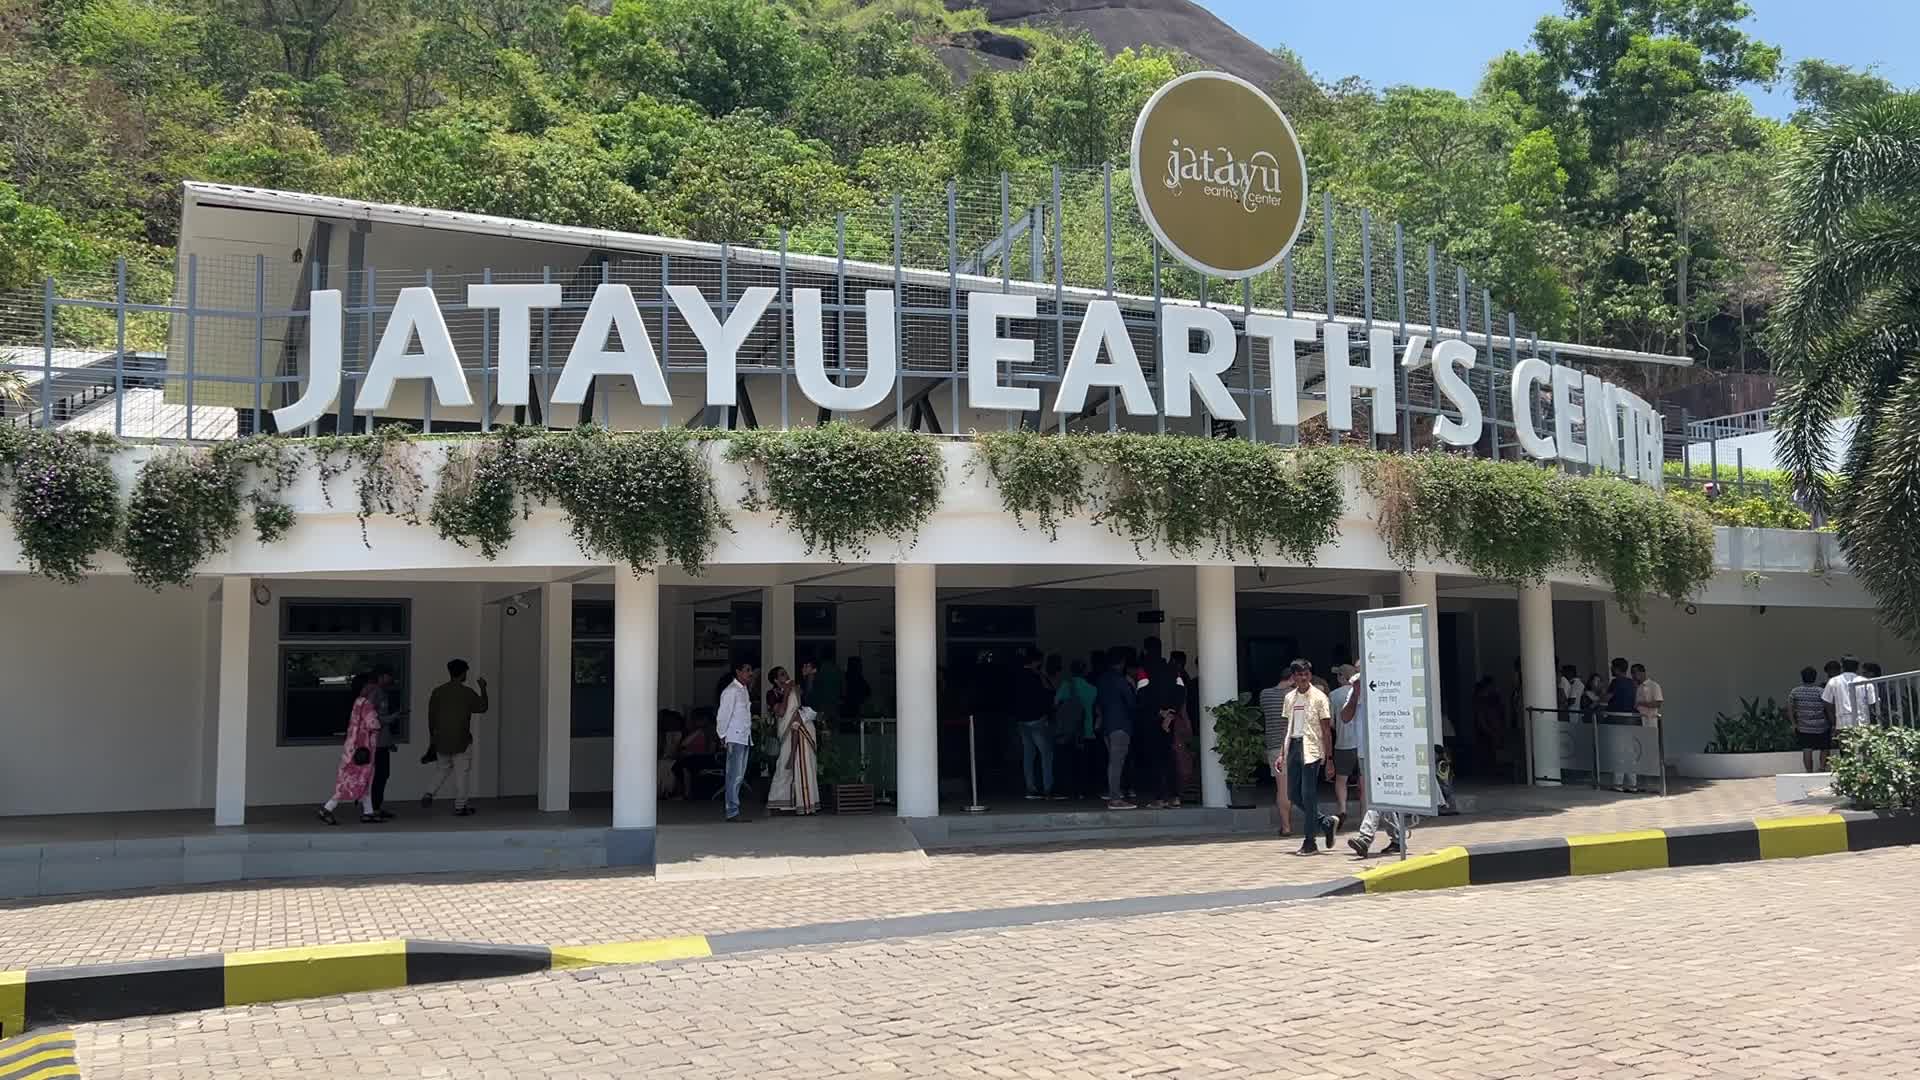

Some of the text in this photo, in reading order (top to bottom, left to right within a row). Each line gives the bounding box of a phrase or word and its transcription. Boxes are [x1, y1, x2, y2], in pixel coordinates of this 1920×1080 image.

[1163, 138, 1282, 213] jatayu
[1203, 185, 1282, 206] earth's center
[272, 284, 897, 433] JATAYU
[968, 292, 1483, 446] EARTH'S
[1377, 680, 1401, 688] Entry Point
[1379, 710, 1396, 718] Security
